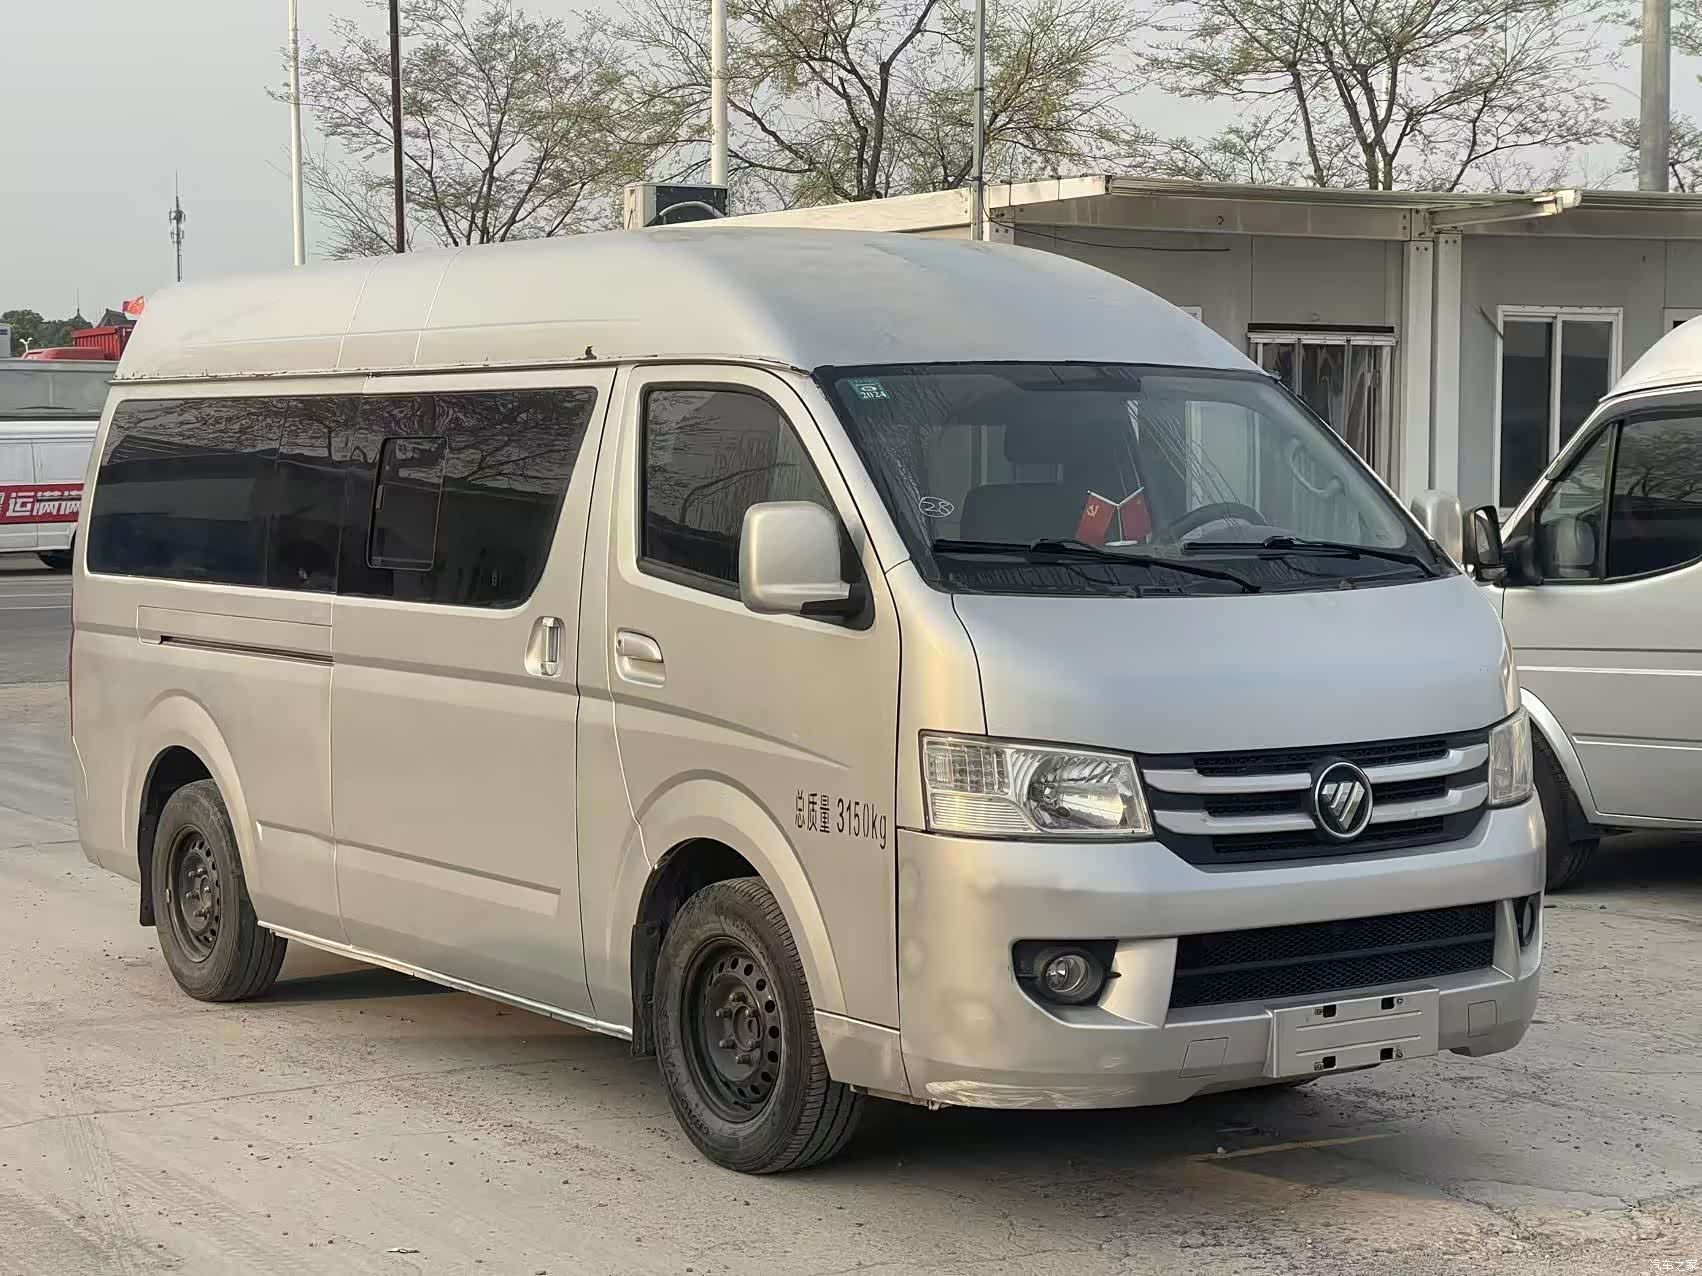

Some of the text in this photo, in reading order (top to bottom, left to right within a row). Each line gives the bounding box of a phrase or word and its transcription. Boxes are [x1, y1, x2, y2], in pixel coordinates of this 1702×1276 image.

[795, 789, 830, 833] 总质量
[836, 798, 887, 850] 3150kg
